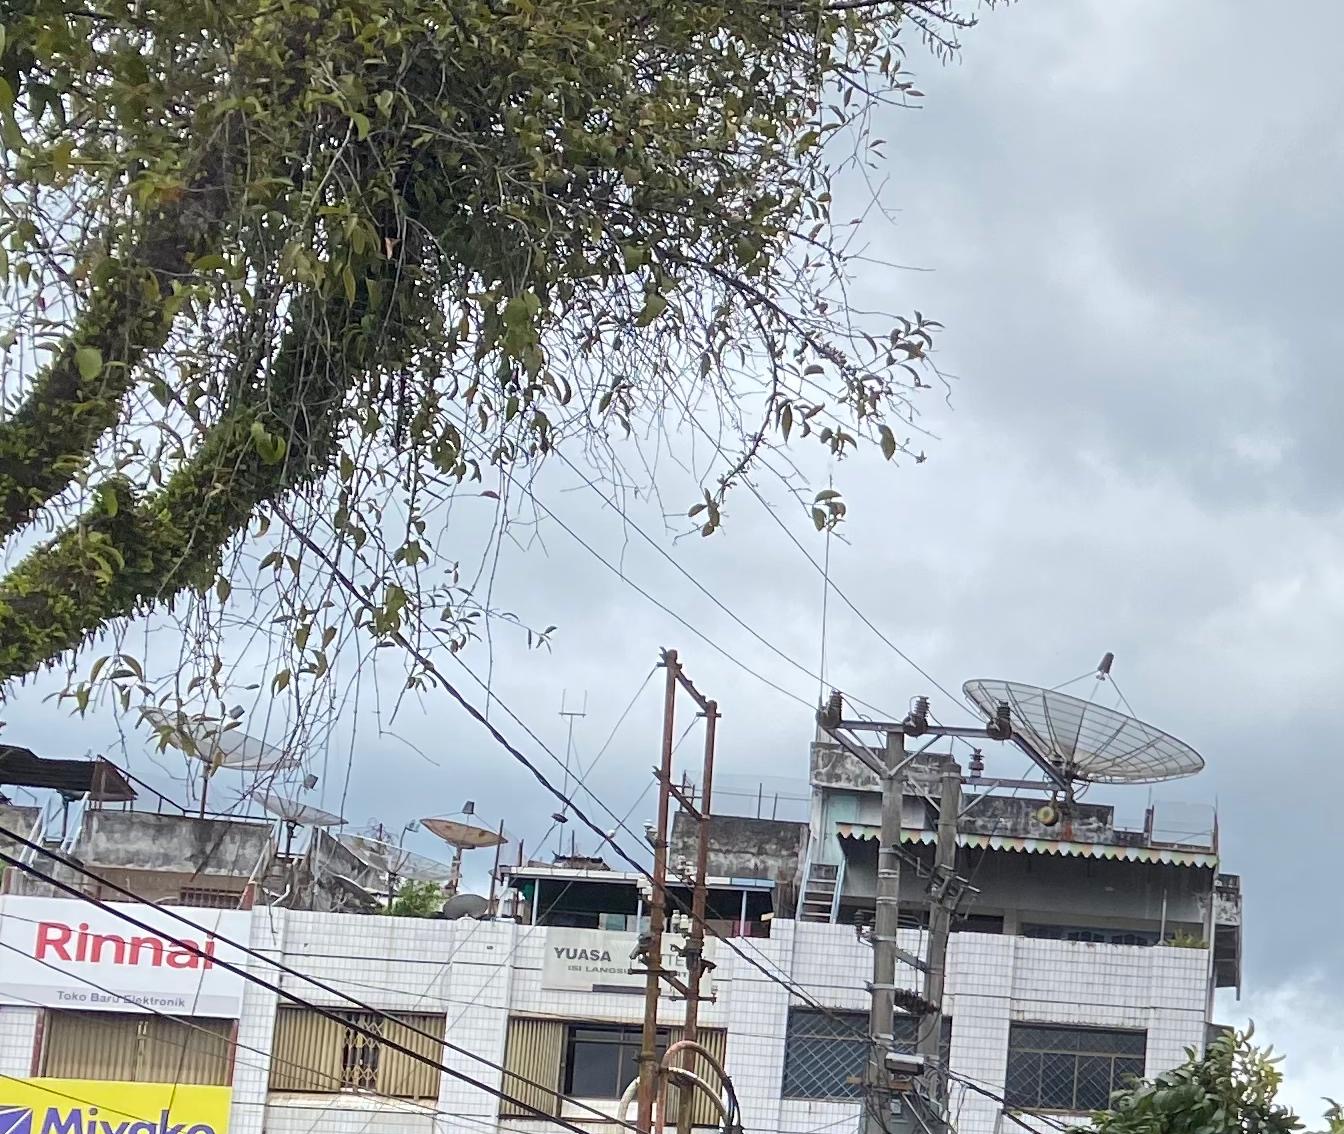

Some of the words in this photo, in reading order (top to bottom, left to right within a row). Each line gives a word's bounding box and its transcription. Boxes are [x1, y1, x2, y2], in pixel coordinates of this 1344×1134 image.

[35, 921, 216, 970] Rinnai
[554, 946, 612, 962] YUASA
[58, 990, 87, 1002] Toko
[90, 992, 120, 1004] Baru
[123, 994, 185, 1008] Elektronik
